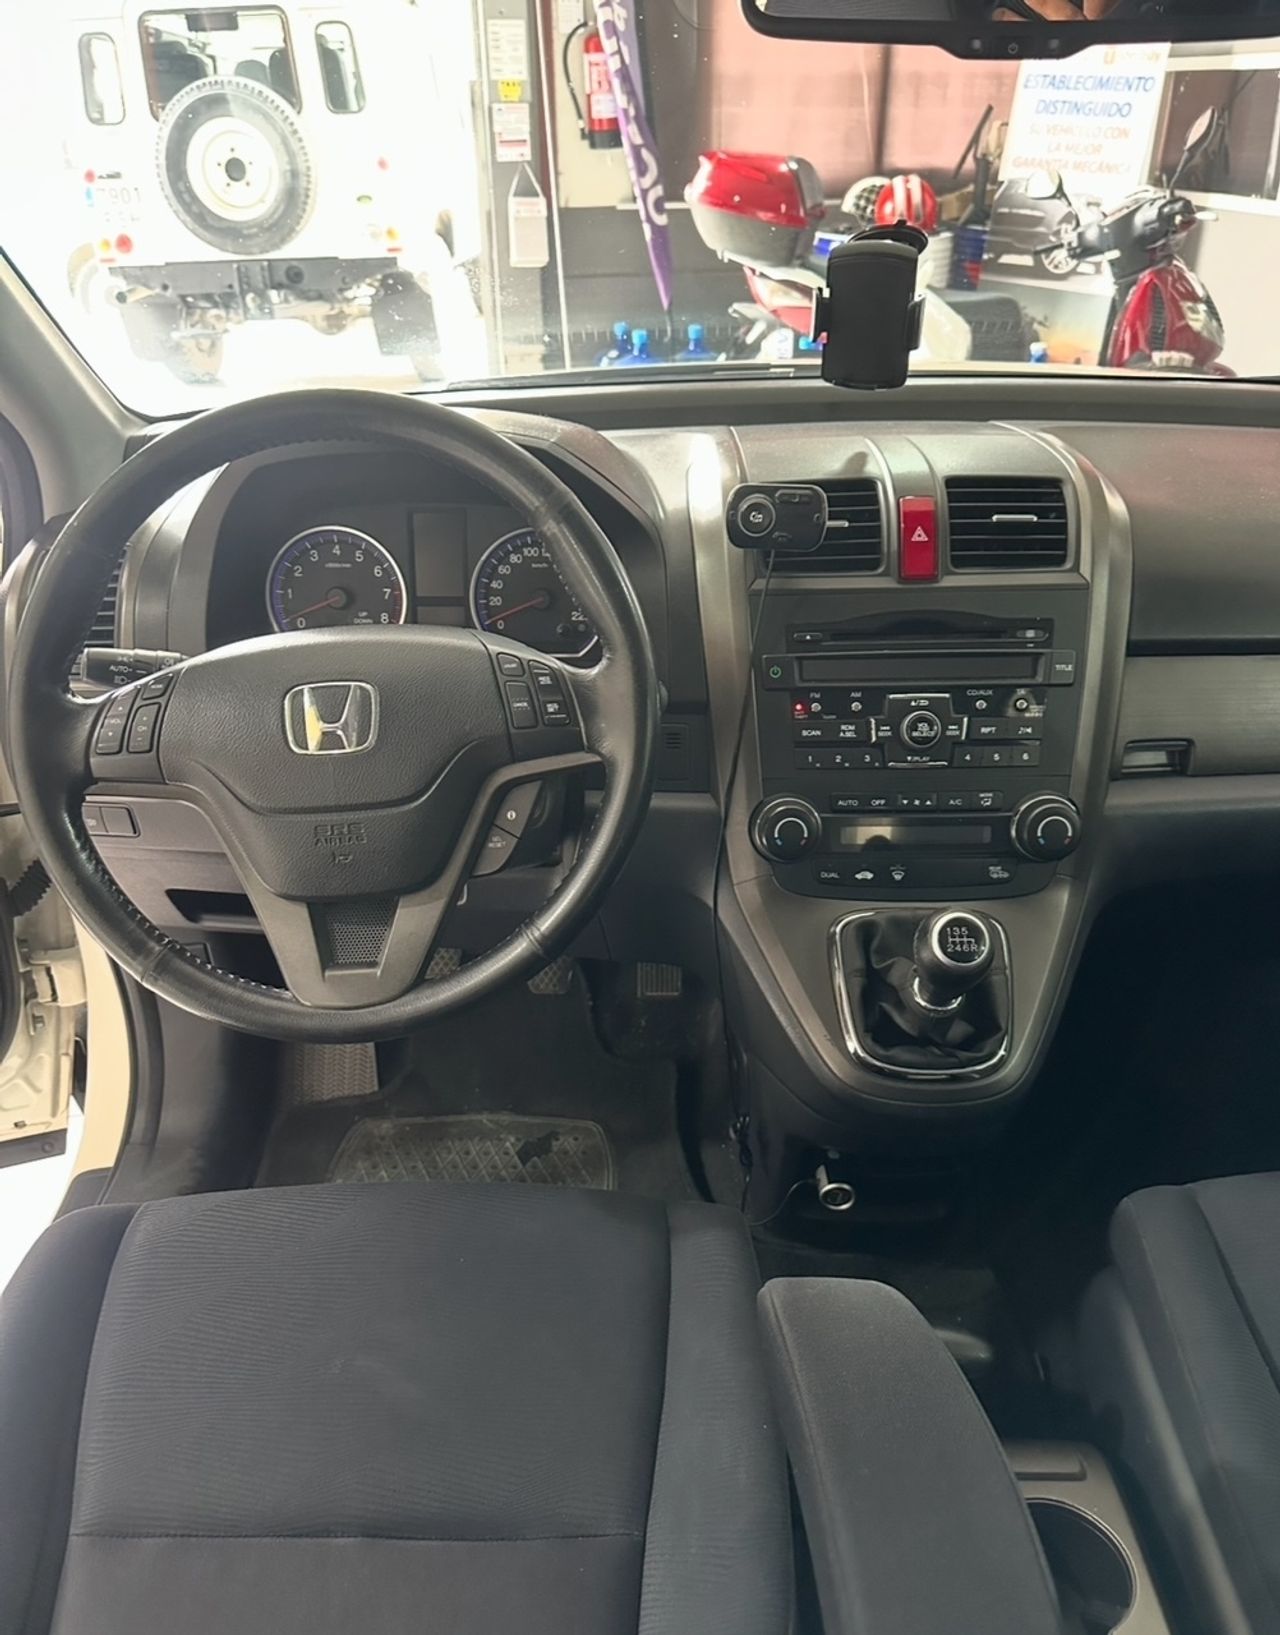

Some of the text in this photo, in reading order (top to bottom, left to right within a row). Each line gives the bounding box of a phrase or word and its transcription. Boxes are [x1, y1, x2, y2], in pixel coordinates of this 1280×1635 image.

[1023, 73, 1156, 92] ESTABLECIMIENTO
[1035, 99, 1132, 118] DISTINGUIDO
[1103, 127, 1131, 140] CON
[332, 545, 340, 556] 4
[522, 548, 540, 556] 100
[310, 550, 319, 562] 3
[355, 550, 364, 562] 5
[509, 554, 522, 564] 80
[294, 565, 303, 576] 2
[374, 566, 382, 577] 6
[498, 565, 511, 574] 60
[490, 580, 503, 589] 40
[288, 588, 292, 598] 1
[384, 588, 391, 599] 7
[489, 597, 502, 606] 20
[297, 618, 306, 628] 0
[380, 612, 389, 624] 8
[497, 620, 504, 629] 0
[835, 754, 842, 762] 2
[864, 754, 870, 762] 3
[994, 752, 1000, 761] 5
[1022, 752, 1029, 760] 6
[952, 927, 960, 935] 3
[961, 926, 968, 935] 5
[947, 944, 978, 952] 2 4 6 R
